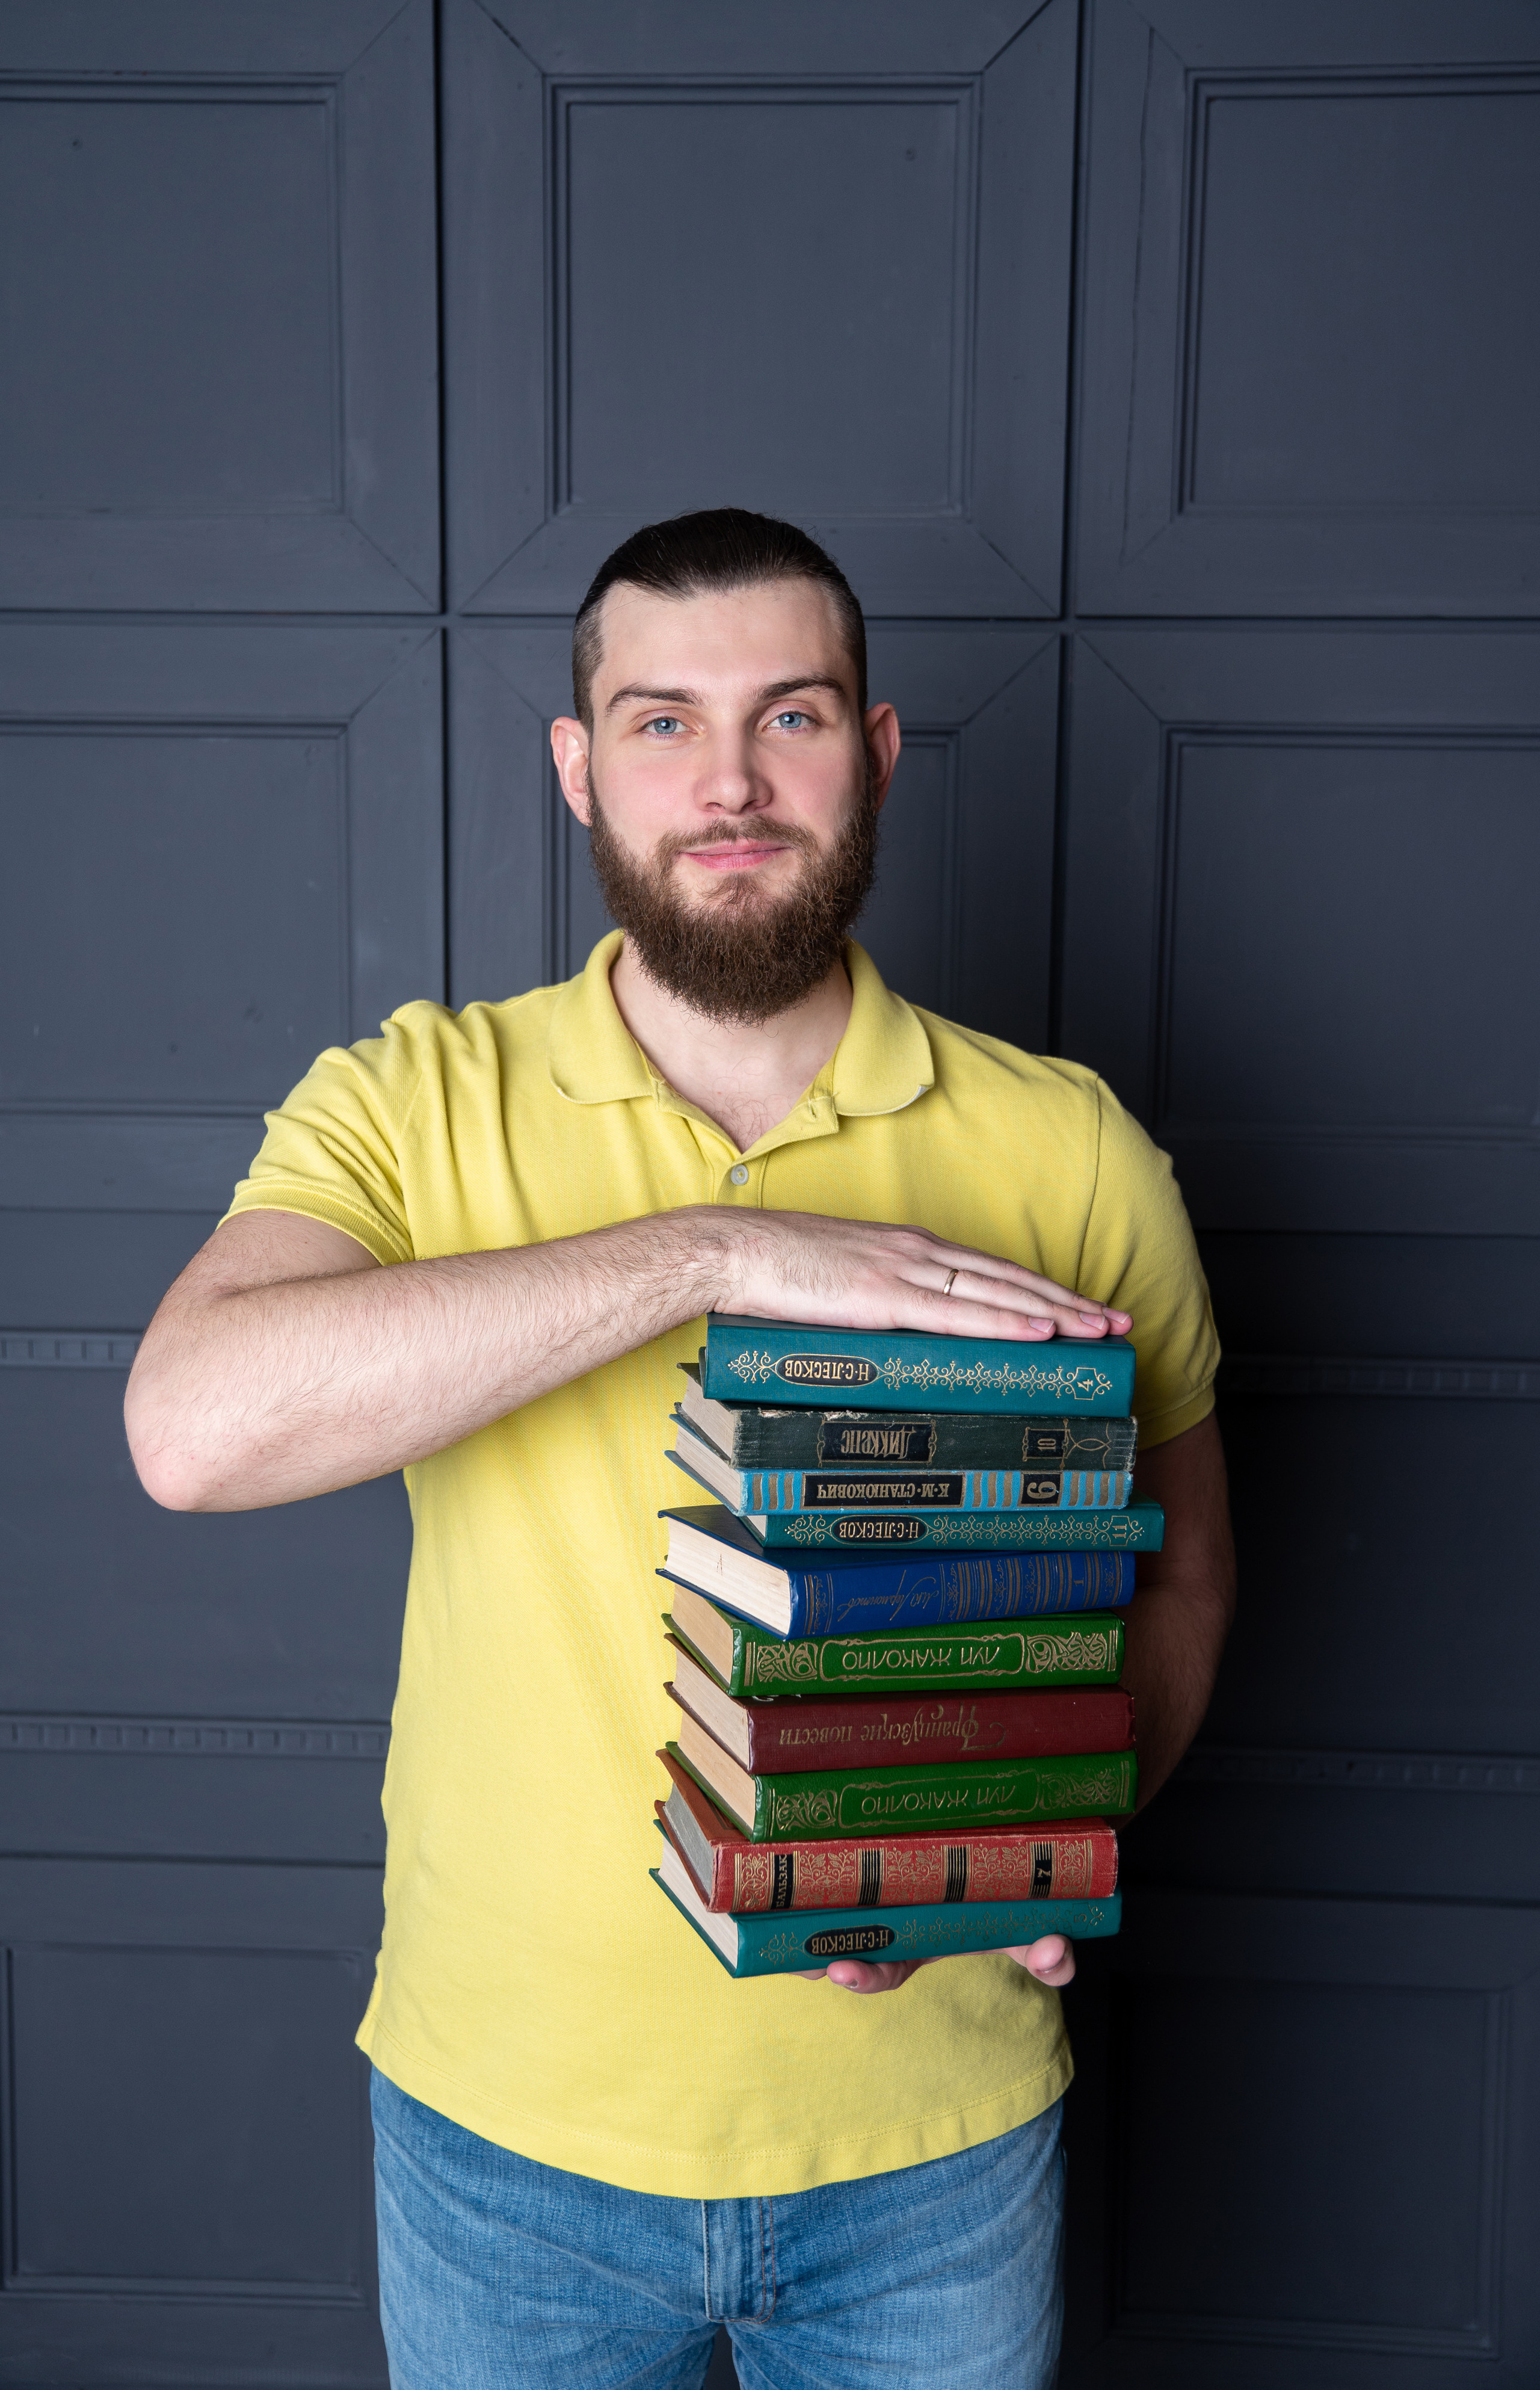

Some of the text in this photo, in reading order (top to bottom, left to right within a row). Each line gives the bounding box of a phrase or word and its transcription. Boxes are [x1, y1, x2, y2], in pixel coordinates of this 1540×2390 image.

[1076, 1379, 1094, 1392] 4
[1037, 1437, 1057, 1451] 10
[1026, 1481, 1058, 1499] 6
[1112, 1524, 1127, 1539] 11
[1073, 1576, 1085, 1587] 1
[842, 1646, 1000, 1670] ЛУИ ЖАКОЛИО
[779, 1702, 1006, 1752] Французские повести
[861, 1785, 1016, 1815] ЛУИ ЖАКОЛИО
[775, 1853, 787, 1908] БАЛЬЗАК
[1036, 1867, 1052, 1879] 7
[1073, 1913, 1087, 1923] 5
